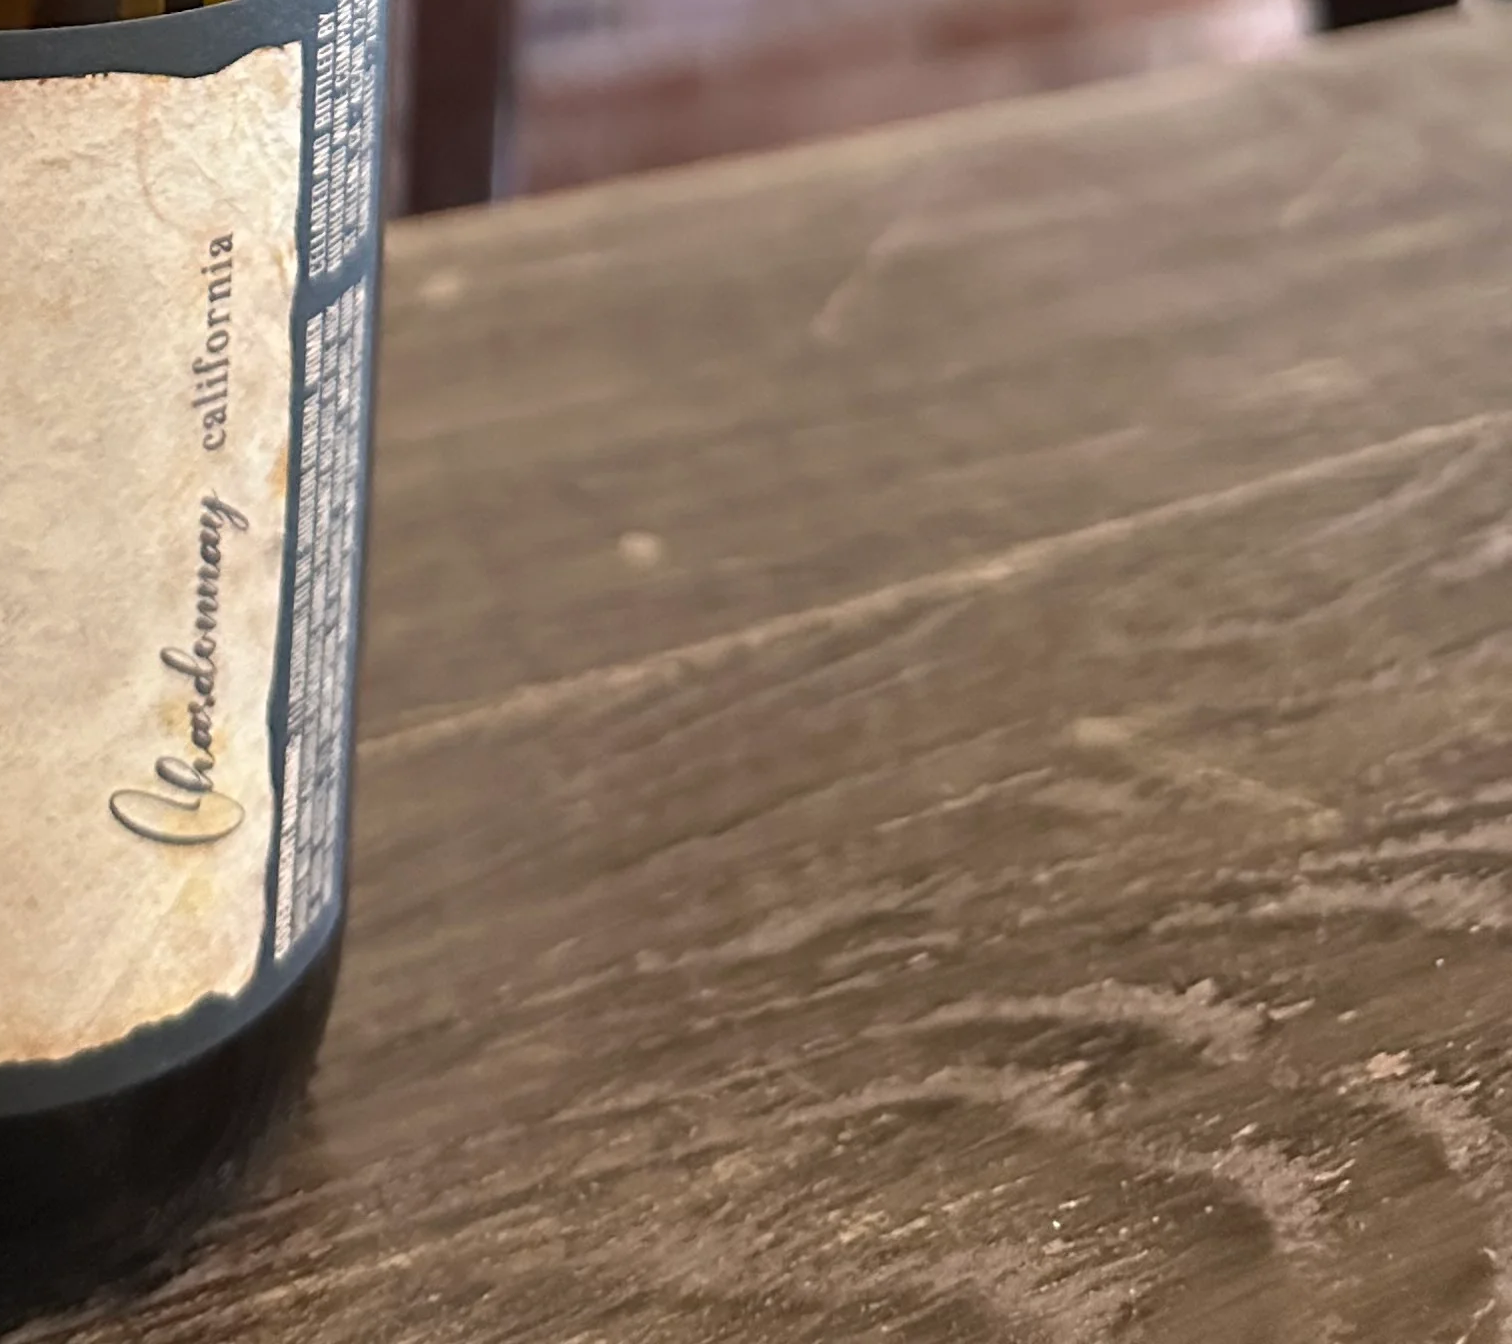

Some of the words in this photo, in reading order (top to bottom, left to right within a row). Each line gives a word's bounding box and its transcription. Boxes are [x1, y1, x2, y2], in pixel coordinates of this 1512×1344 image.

[317, 11, 336, 40] BY
[314, 42, 335, 131] BOTTLED
[332, 93, 350, 145] WINE
[313, 132, 331, 176] AND
[309, 179, 329, 278] CELLARED
[109, 488, 248, 845] Chardonnay
[191, 233, 234, 452] california
